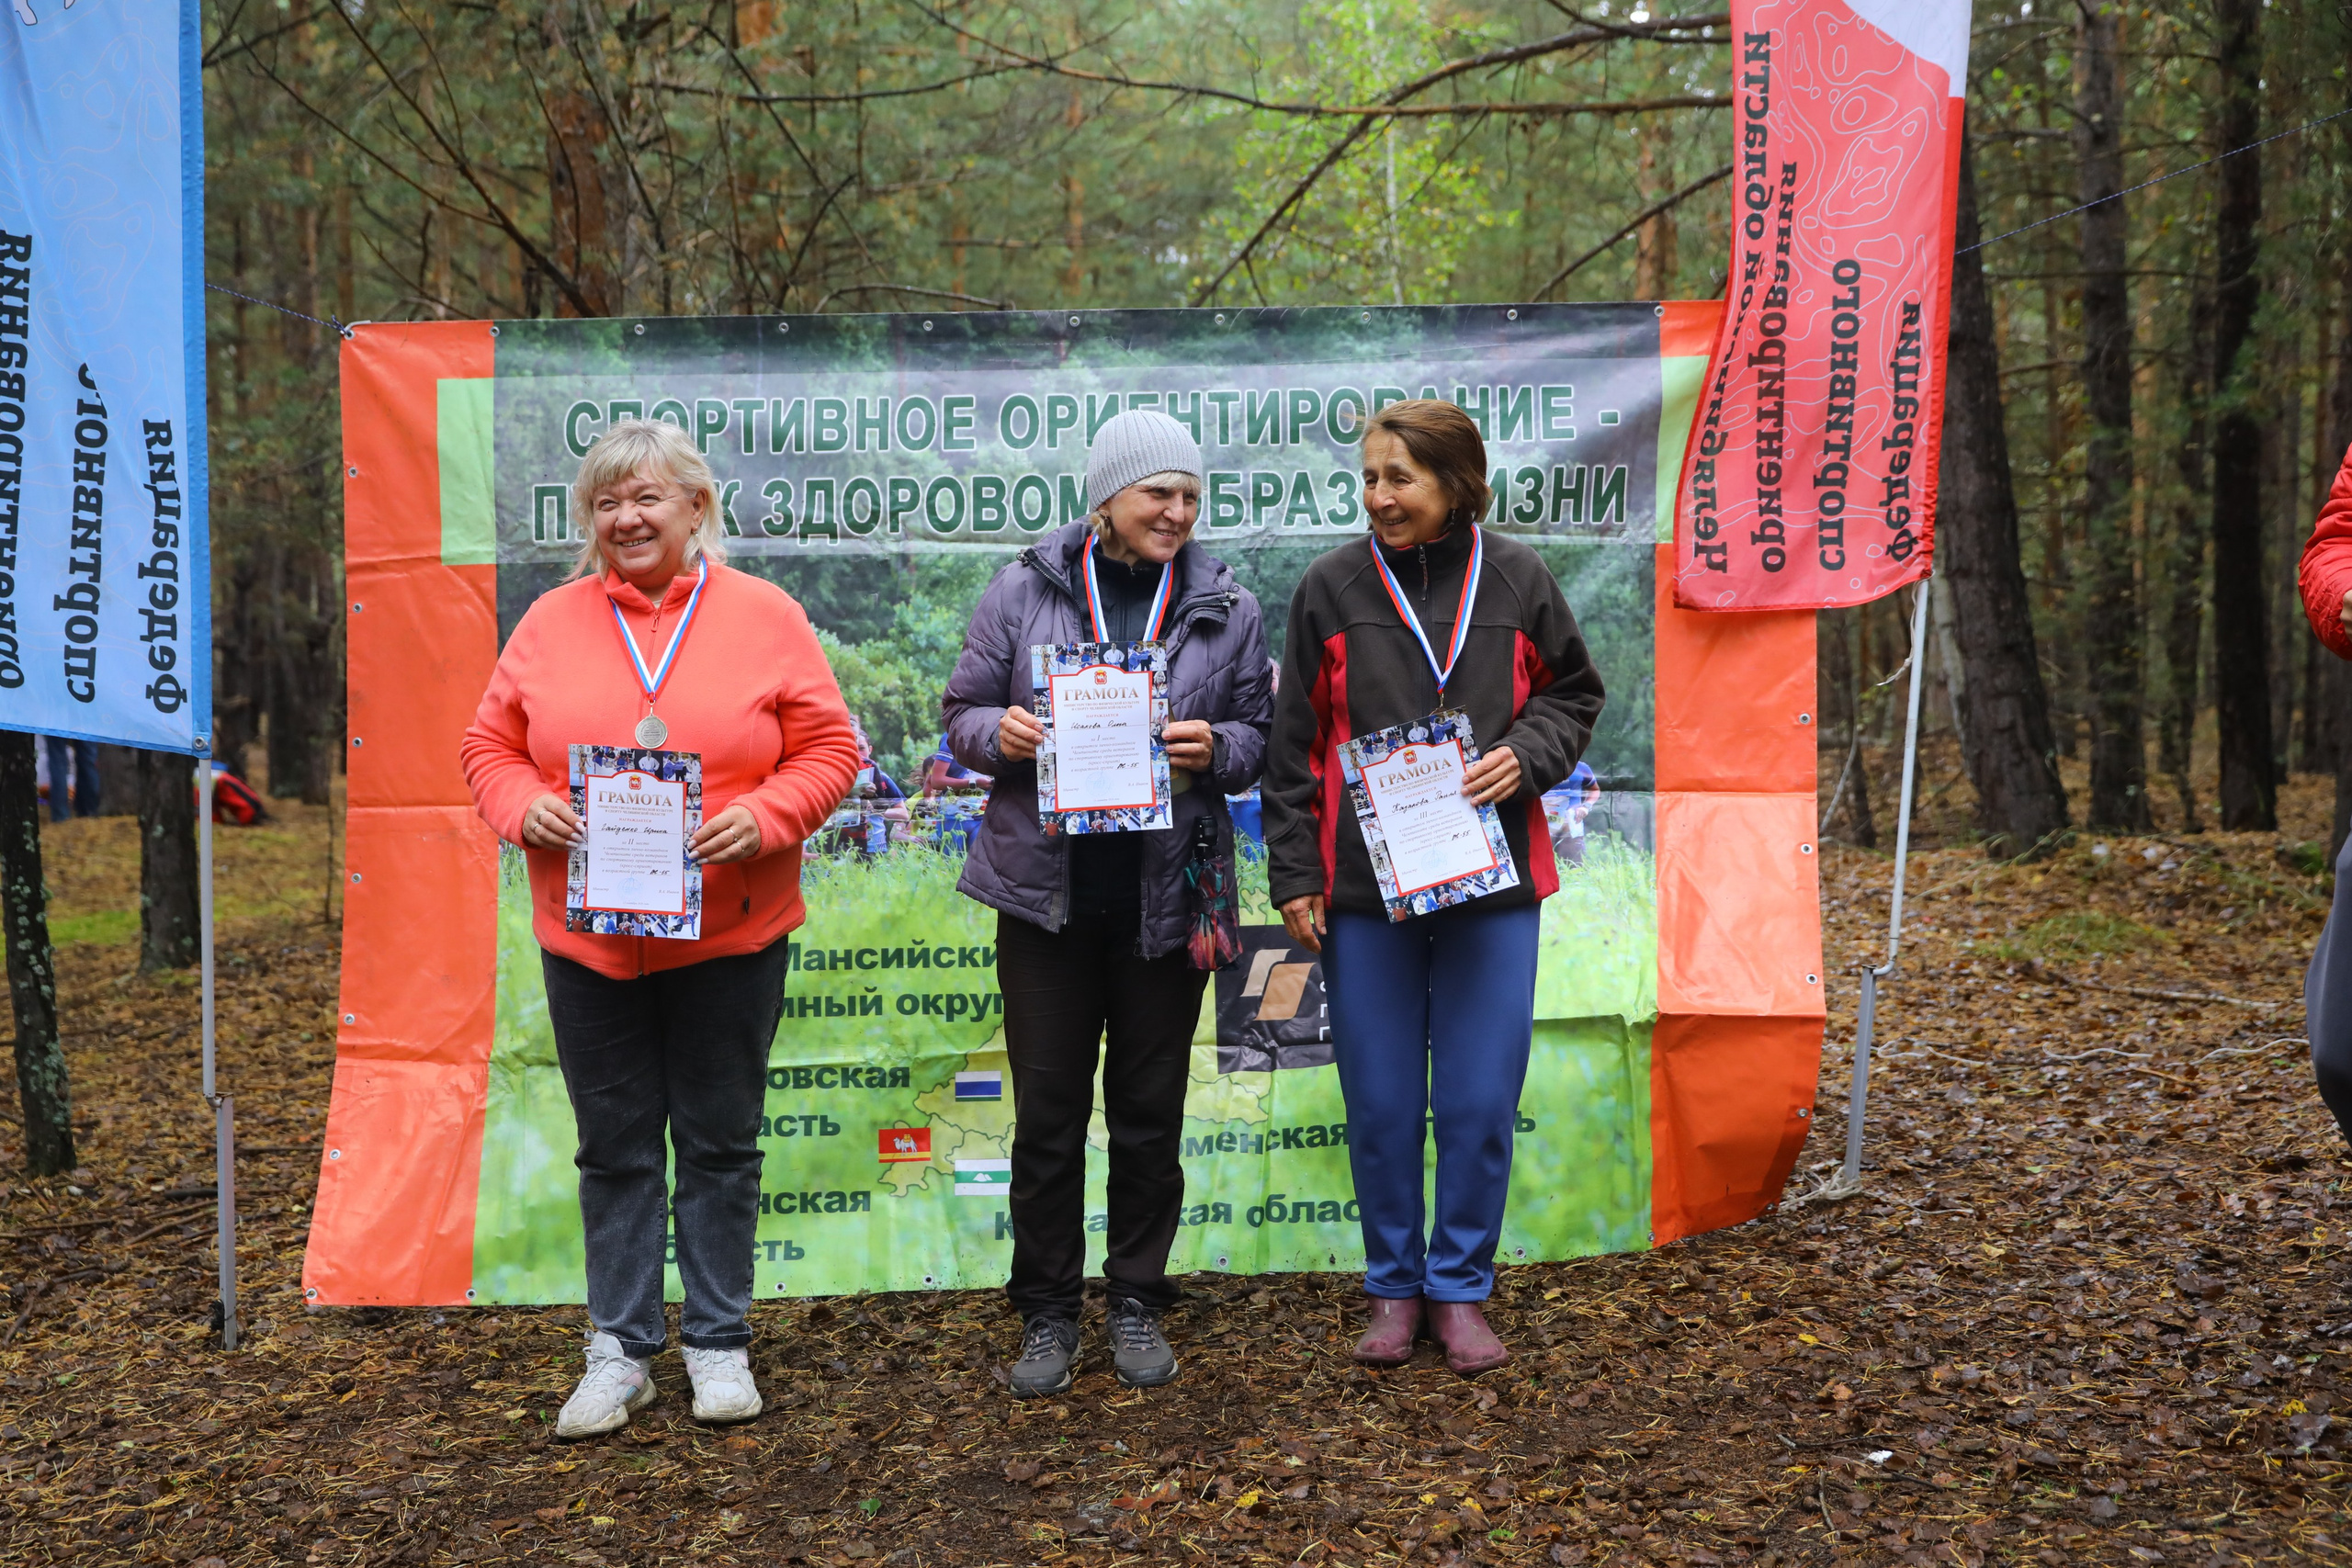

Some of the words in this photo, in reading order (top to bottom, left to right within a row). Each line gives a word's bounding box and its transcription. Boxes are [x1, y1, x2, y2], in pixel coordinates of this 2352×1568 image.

[1001, 385, 1576, 449] ОРИНТИРОНИЕ
[1195, 471, 1366, 529] БРАЗ
[1063, 685, 1138, 701] ГРАМОТА
[1376, 756, 1452, 788] ГРАМОТА
[597, 790, 673, 807] ГРАМОТА
[896, 992, 1003, 1022] округ
